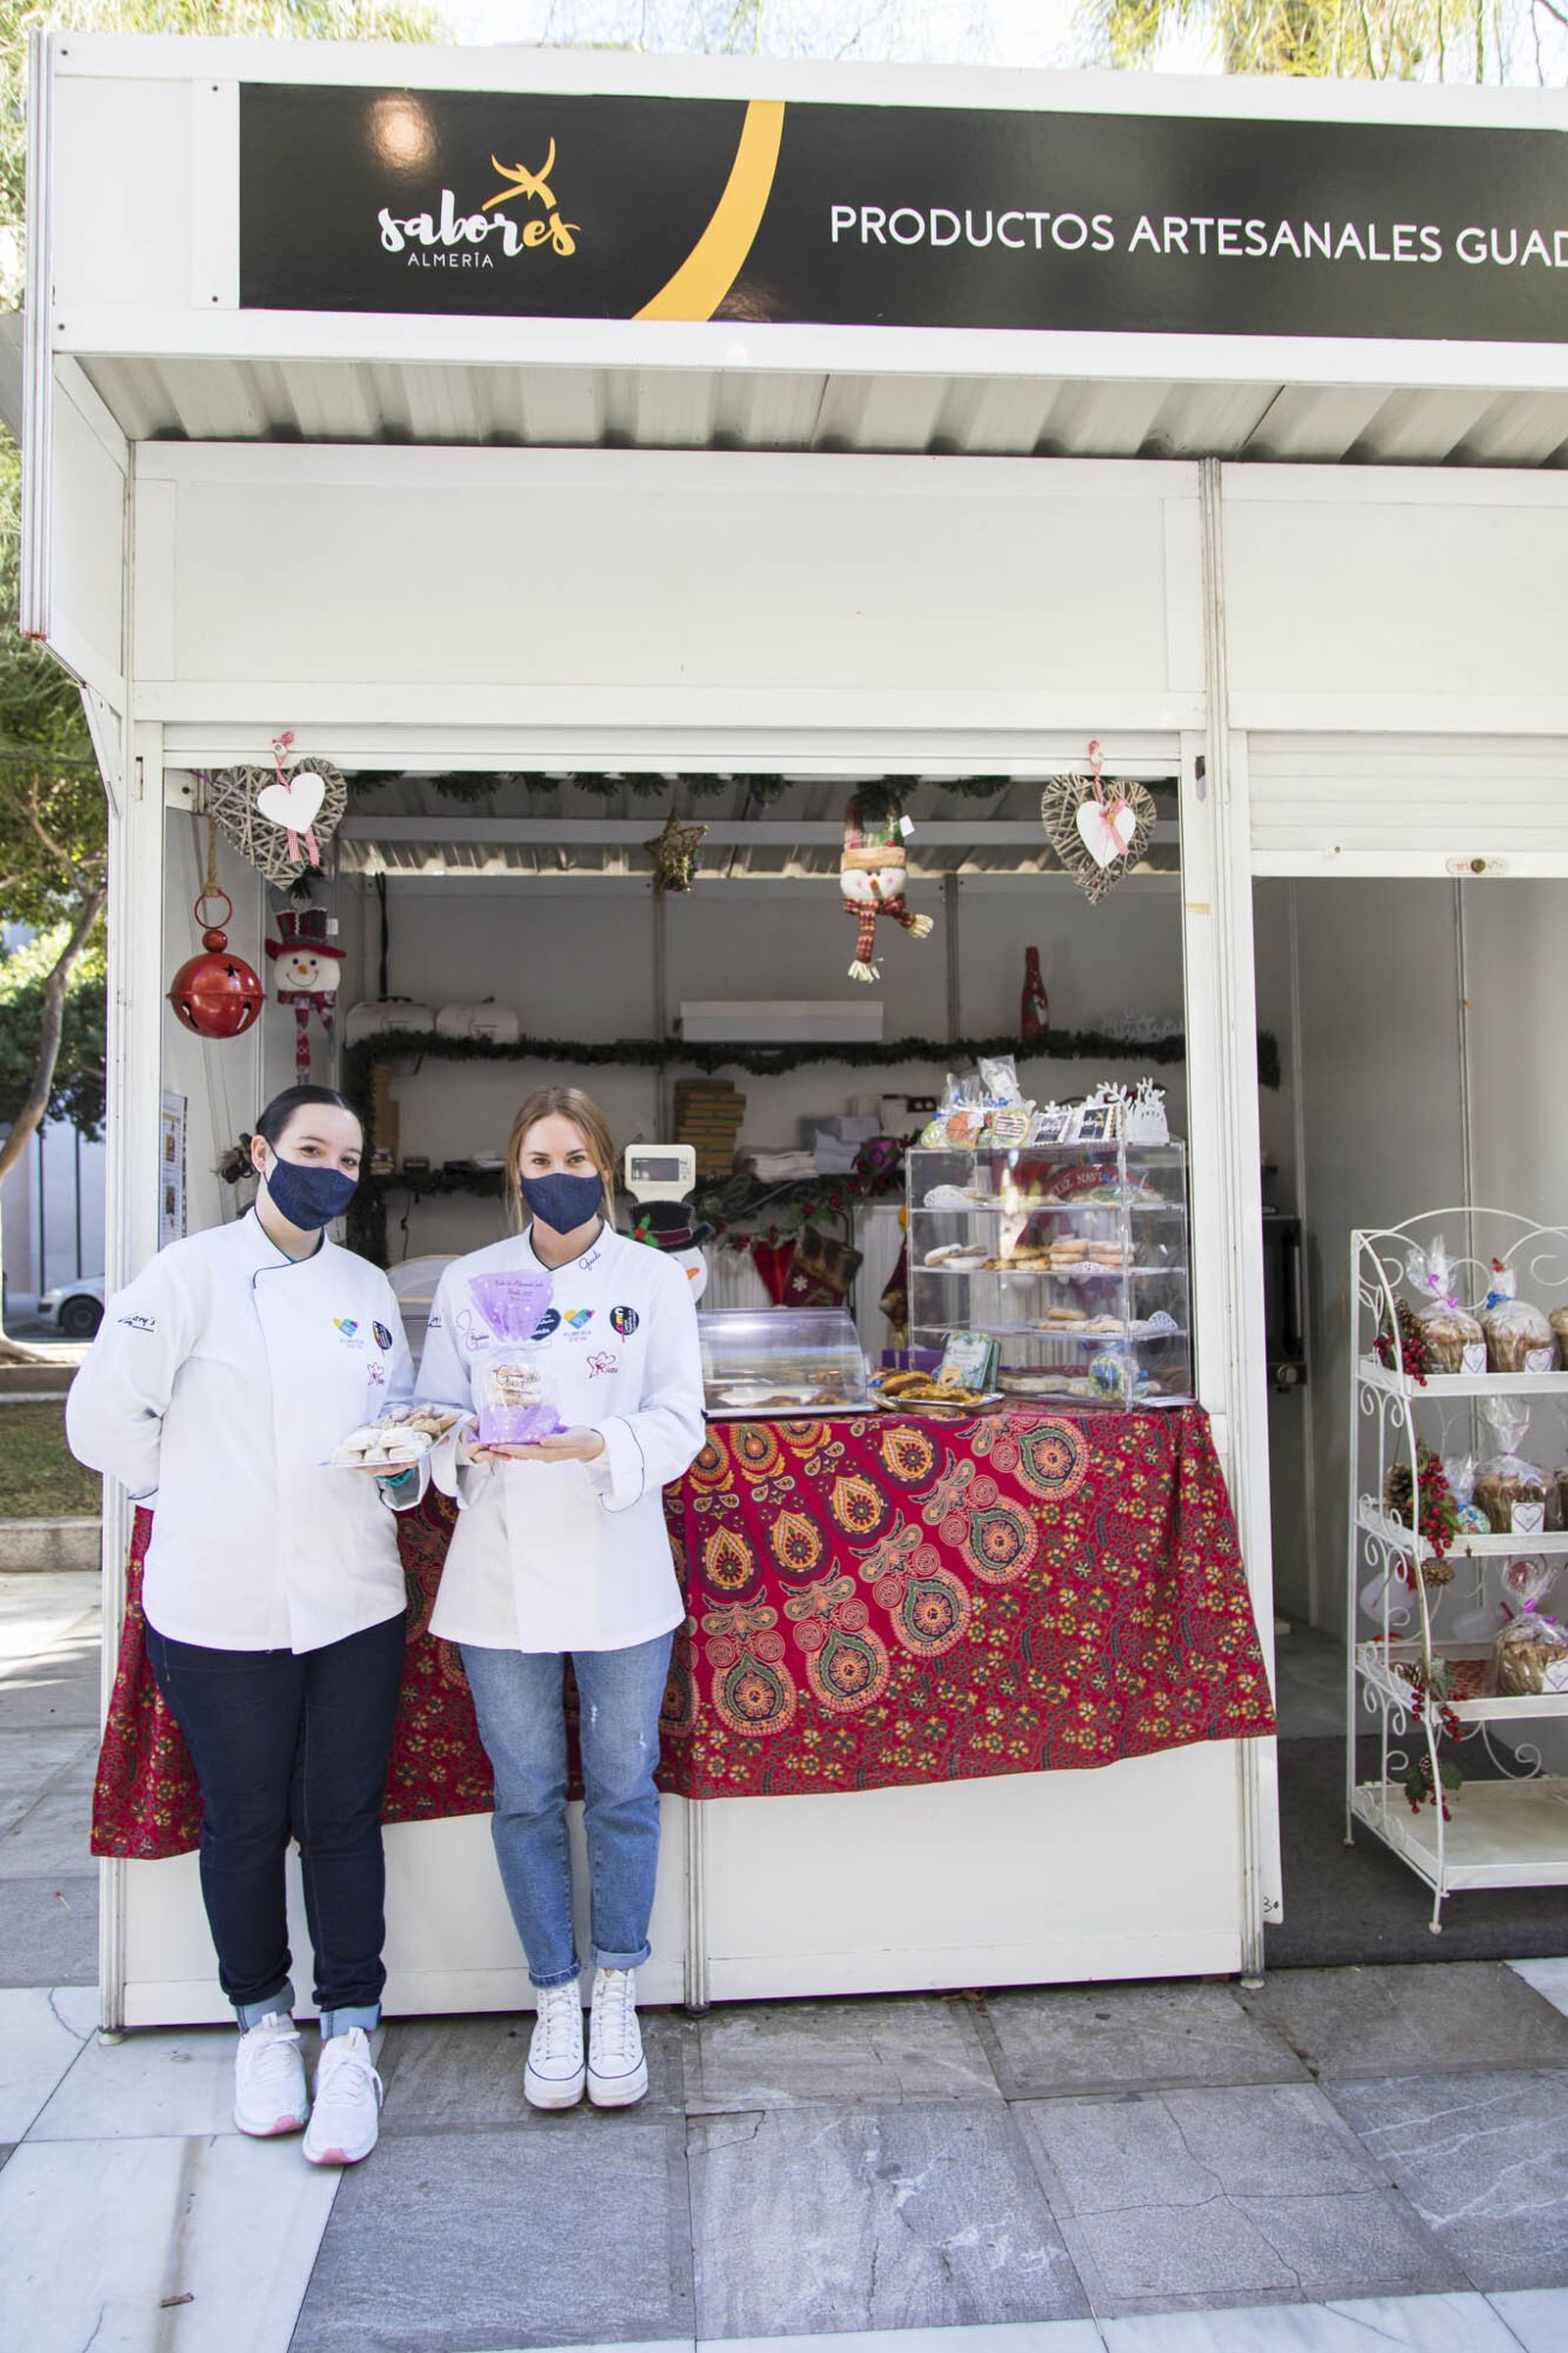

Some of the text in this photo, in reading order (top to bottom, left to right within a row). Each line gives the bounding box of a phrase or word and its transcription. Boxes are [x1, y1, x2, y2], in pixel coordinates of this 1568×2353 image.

[377, 188, 581, 257] sabores
[831, 205, 1115, 251] PRODUCTOS
[1128, 217, 1443, 263] ARTESANALES
